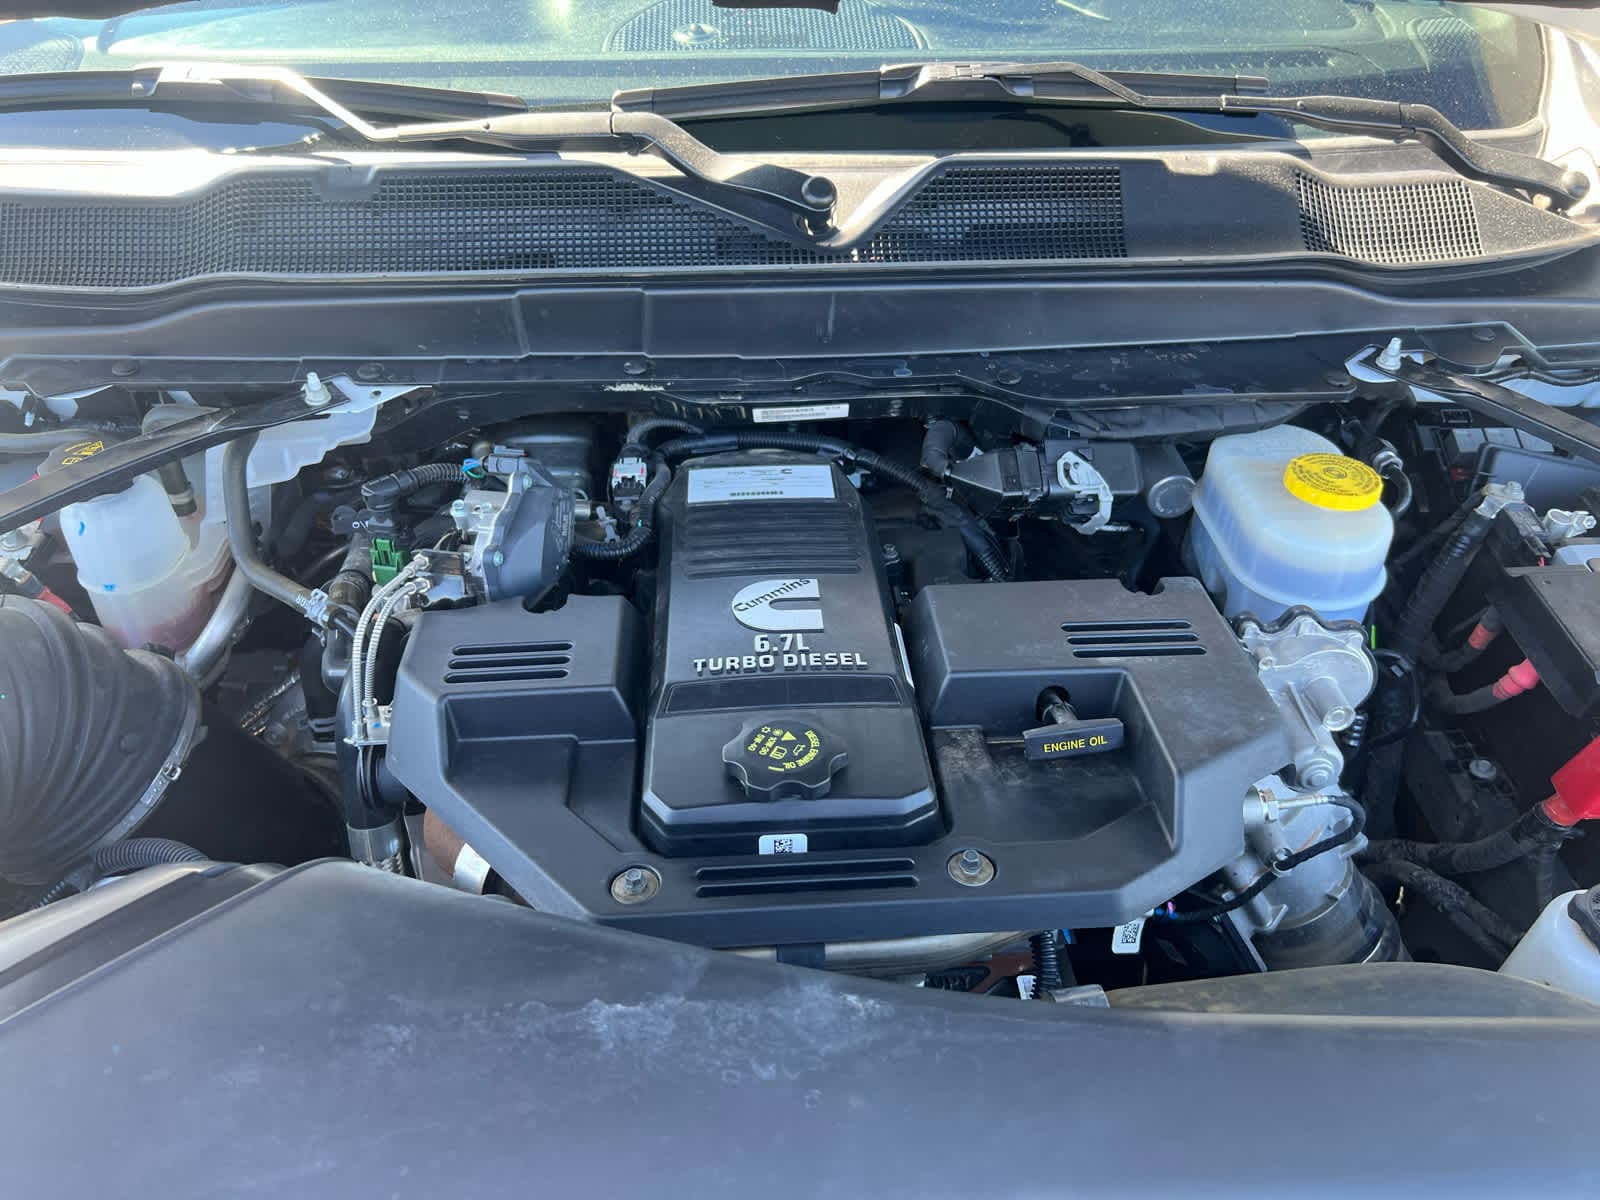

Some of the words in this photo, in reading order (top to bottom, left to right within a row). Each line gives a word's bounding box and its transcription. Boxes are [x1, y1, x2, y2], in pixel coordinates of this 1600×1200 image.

[733, 578, 811, 612] Cummins
[754, 633, 810, 653] 6.7L
[693, 654, 775, 673] TURBO
[783, 652, 868, 668] DIESEL
[1043, 738, 1086, 753] ENGINE
[1089, 735, 1109, 747] OIL
